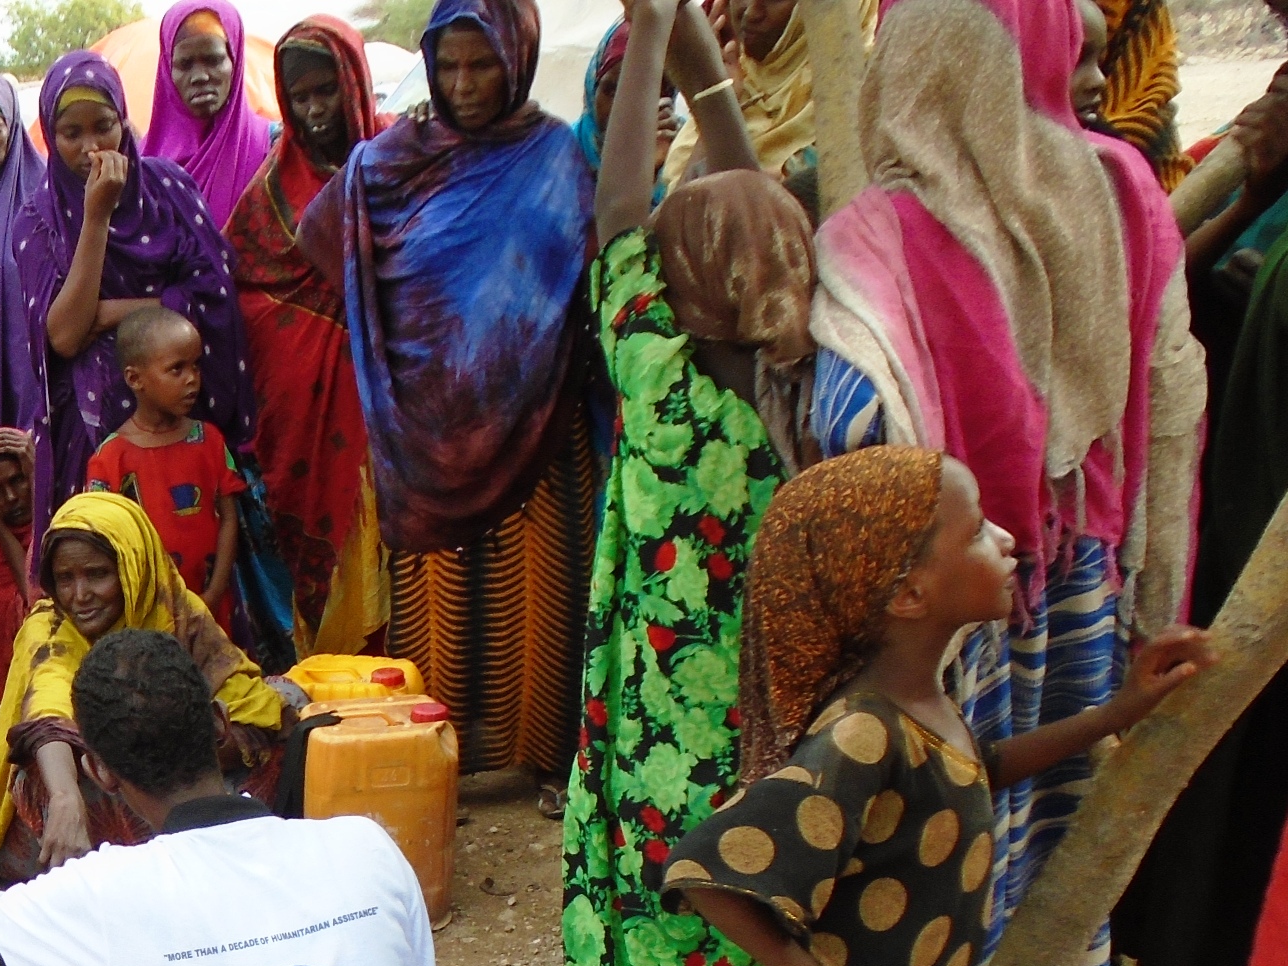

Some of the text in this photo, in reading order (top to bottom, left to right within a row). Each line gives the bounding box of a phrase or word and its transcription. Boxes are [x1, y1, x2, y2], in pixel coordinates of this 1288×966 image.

[164, 906, 379, 962] "MORE THAN A DECADE OF HUMANITARIAN ASSISTANCE"
